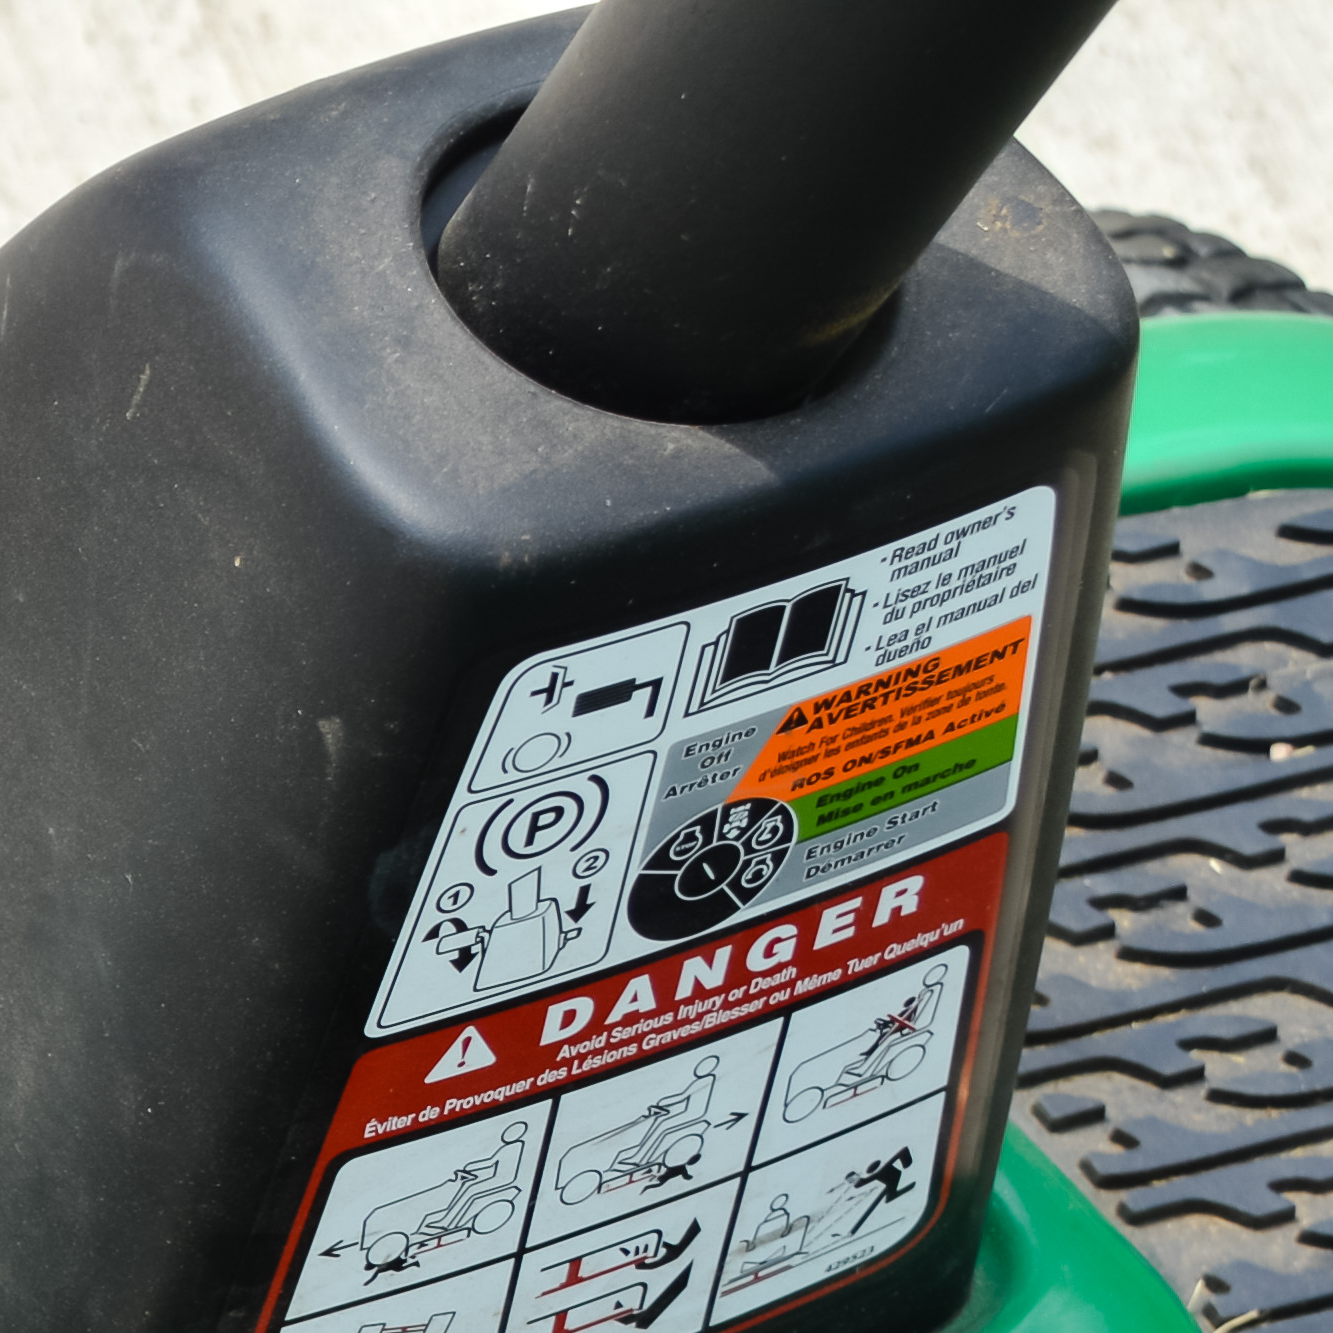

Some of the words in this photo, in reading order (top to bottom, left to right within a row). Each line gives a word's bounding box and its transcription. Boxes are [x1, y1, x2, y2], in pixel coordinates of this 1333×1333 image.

[889, 532, 940, 566] Read
[943, 505, 1017, 545] owner's
[889, 541, 962, 583] manual
[882, 580, 932, 610] Lisez
[935, 571, 953, 590] le
[956, 538, 1027, 581] manuel
[882, 607, 906, 626] du
[909, 562, 1017, 619] propriétaire
[874, 628, 910, 653] Lea
[914, 616, 933, 636] el
[936, 587, 1006, 629] manual
[1008, 572, 1039, 600] del
[874, 635, 932, 668] dueño
[806, 637, 1025, 734] AVERTISSEMENT
[812, 656, 942, 716] WARNING
[683, 726, 757, 759] Engine
[776, 740, 817, 764] Watch
[818, 732, 838, 748] For
[946, 674, 995, 703] toujours
[790, 764, 837, 793] ROS
[841, 730, 935, 775] ON/SFMA
[941, 700, 1007, 735] Activé
[822, 744, 842, 759] les
[844, 728, 891, 753] enfants
[892, 720, 910, 734] de
[911, 713, 922, 728] la
[924, 703, 955, 723] zone
[956, 693, 973, 710] de
[662, 765, 742, 801] Arrêter
[699, 749, 732, 771] Off
[815, 772, 886, 809] Engine
[892, 760, 921, 780] On
[815, 800, 863, 828] Mise
[870, 787, 895, 808] en
[900, 757, 978, 797] marche
[523, 804, 565, 849] P
[804, 833, 907, 882] Démarrer
[805, 825, 879, 862] Engine
[885, 799, 940, 832] Start
[539, 874, 925, 1047] DANGER
[363, 1111, 414, 1140] Éviter
[417, 1104, 441, 1124] de
[442, 1076, 535, 1115] Provoquer
[536, 1066, 568, 1087] des
[570, 1041, 638, 1076] Lésions
[641, 997, 765, 1051] Graves/Blesser
[768, 987, 791, 1006] ou
[793, 966, 843, 997] Même
[846, 951, 882, 976] Tuer
[883, 917, 965, 961] Quelqu'un
[556, 1034, 608, 1062] Avoid
[609, 1009, 673, 1044] Serious
[677, 991, 725, 1023] Injury
[727, 984, 748, 1003] or
[748, 964, 798, 995] Death
